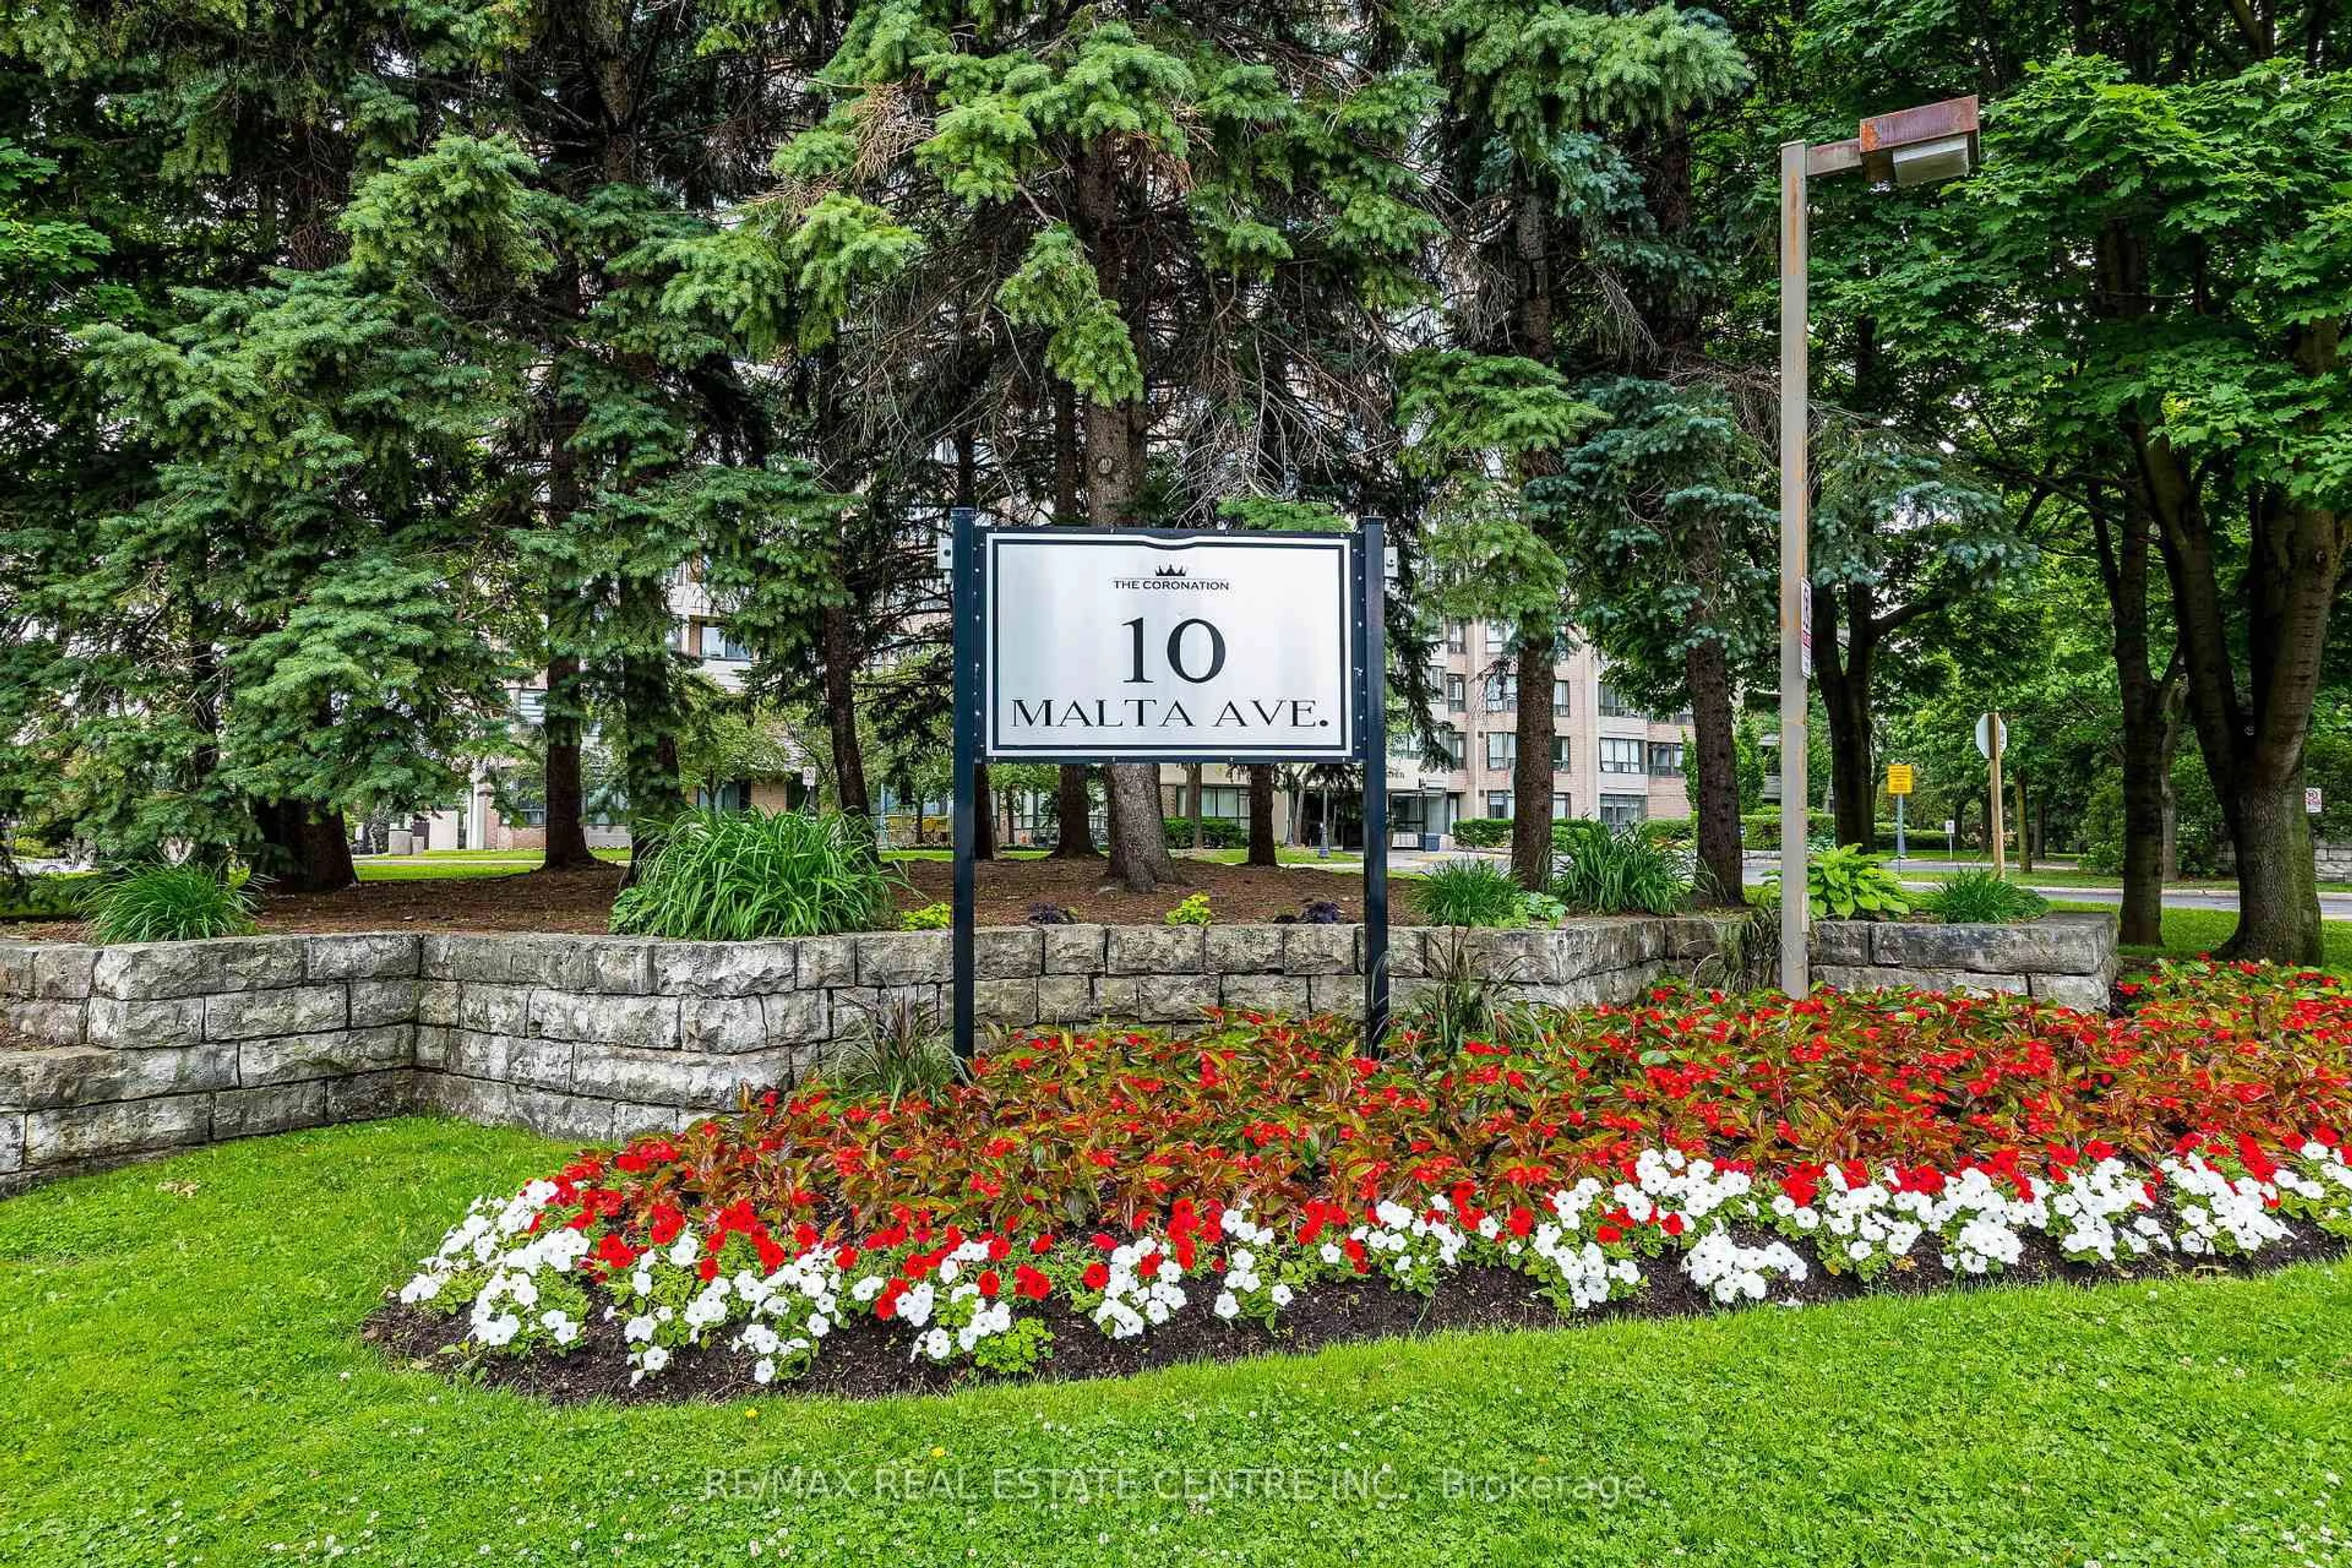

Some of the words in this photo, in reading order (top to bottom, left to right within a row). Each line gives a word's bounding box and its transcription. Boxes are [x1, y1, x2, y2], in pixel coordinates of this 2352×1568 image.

[1113, 580, 1140, 589] THE
[1143, 580, 1230, 590] CORONATION
[1122, 617, 1226, 684] 10
[1012, 699, 1196, 727] MALTA
[1211, 699, 1329, 727] AVE.
